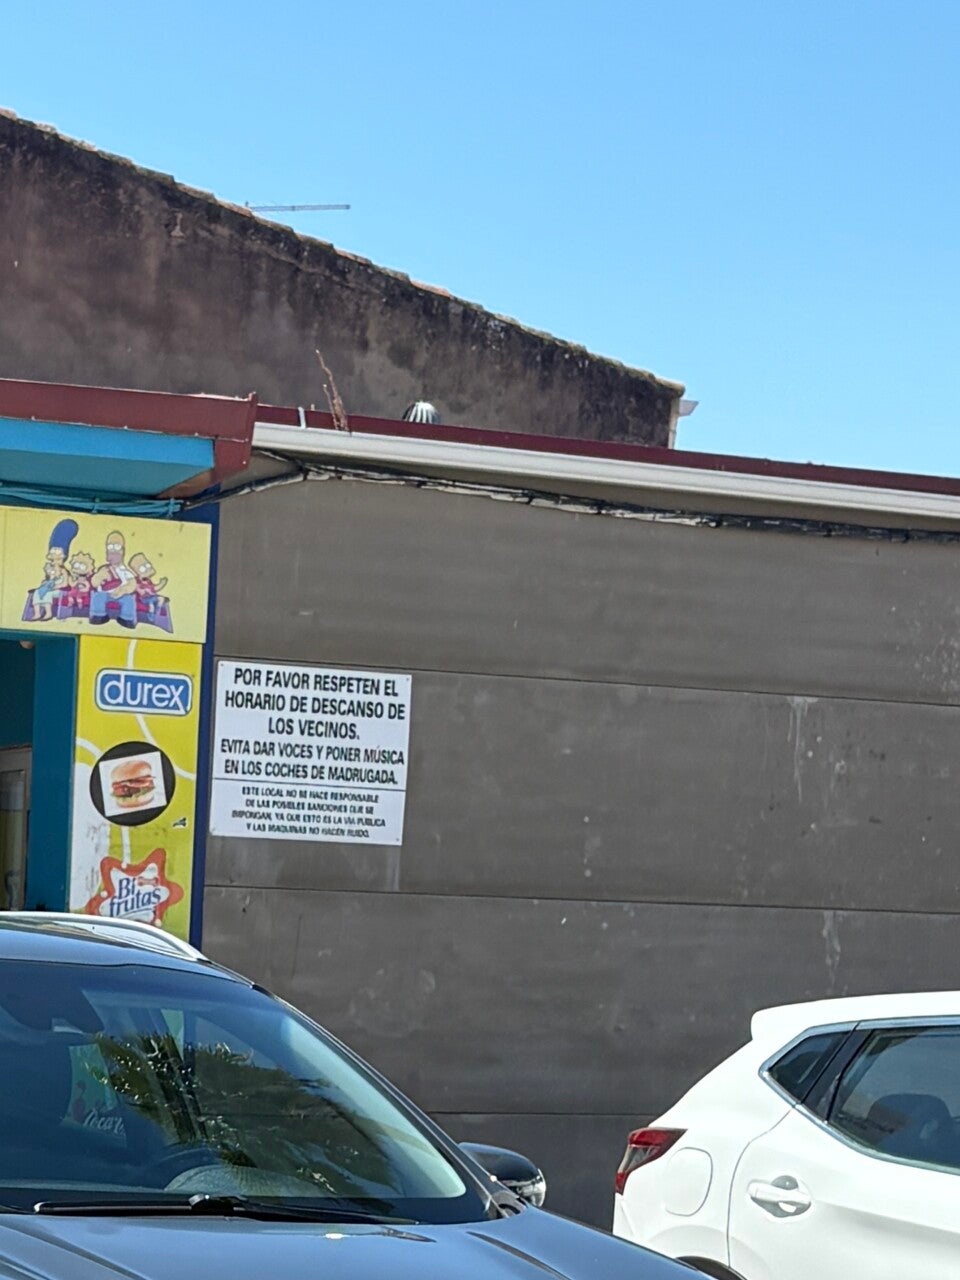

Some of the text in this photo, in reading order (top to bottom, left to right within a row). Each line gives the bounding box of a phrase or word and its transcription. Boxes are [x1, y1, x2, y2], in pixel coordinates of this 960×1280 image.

[103, 672, 186, 711] durex
[234, 668, 398, 696] POR FAVOR RESPETEN EL
[225, 690, 405, 720] HORARIO DE DESCANSO DE
[268, 717, 360, 740] LOS VECINOS.
[221, 738, 404, 765] EVITA DAR VOCES Y PONER MÚSICA
[224, 759, 239, 774] EN
[242, 761, 262, 775] LOS
[265, 762, 308, 779] COCHES
[311, 765, 325, 780] DE
[109, 887, 161, 917] frutas
